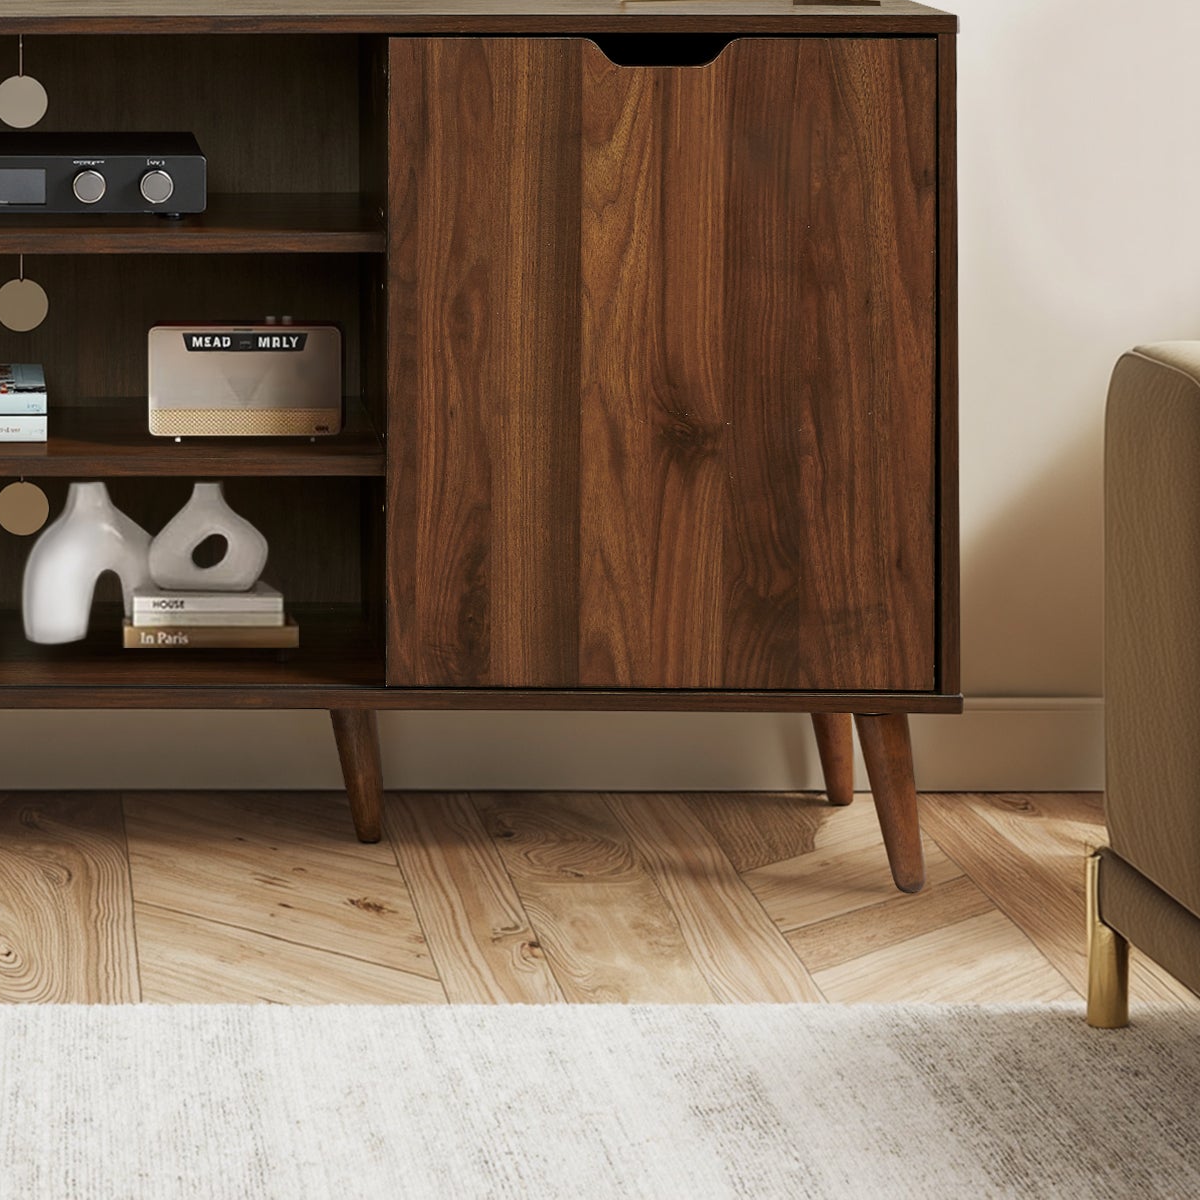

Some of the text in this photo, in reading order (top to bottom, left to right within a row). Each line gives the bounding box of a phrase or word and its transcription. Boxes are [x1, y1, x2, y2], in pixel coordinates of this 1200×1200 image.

[192, 336, 231, 348] MEAD
[152, 600, 185, 609] HOUSE
[140, 631, 189, 644] In Paris
